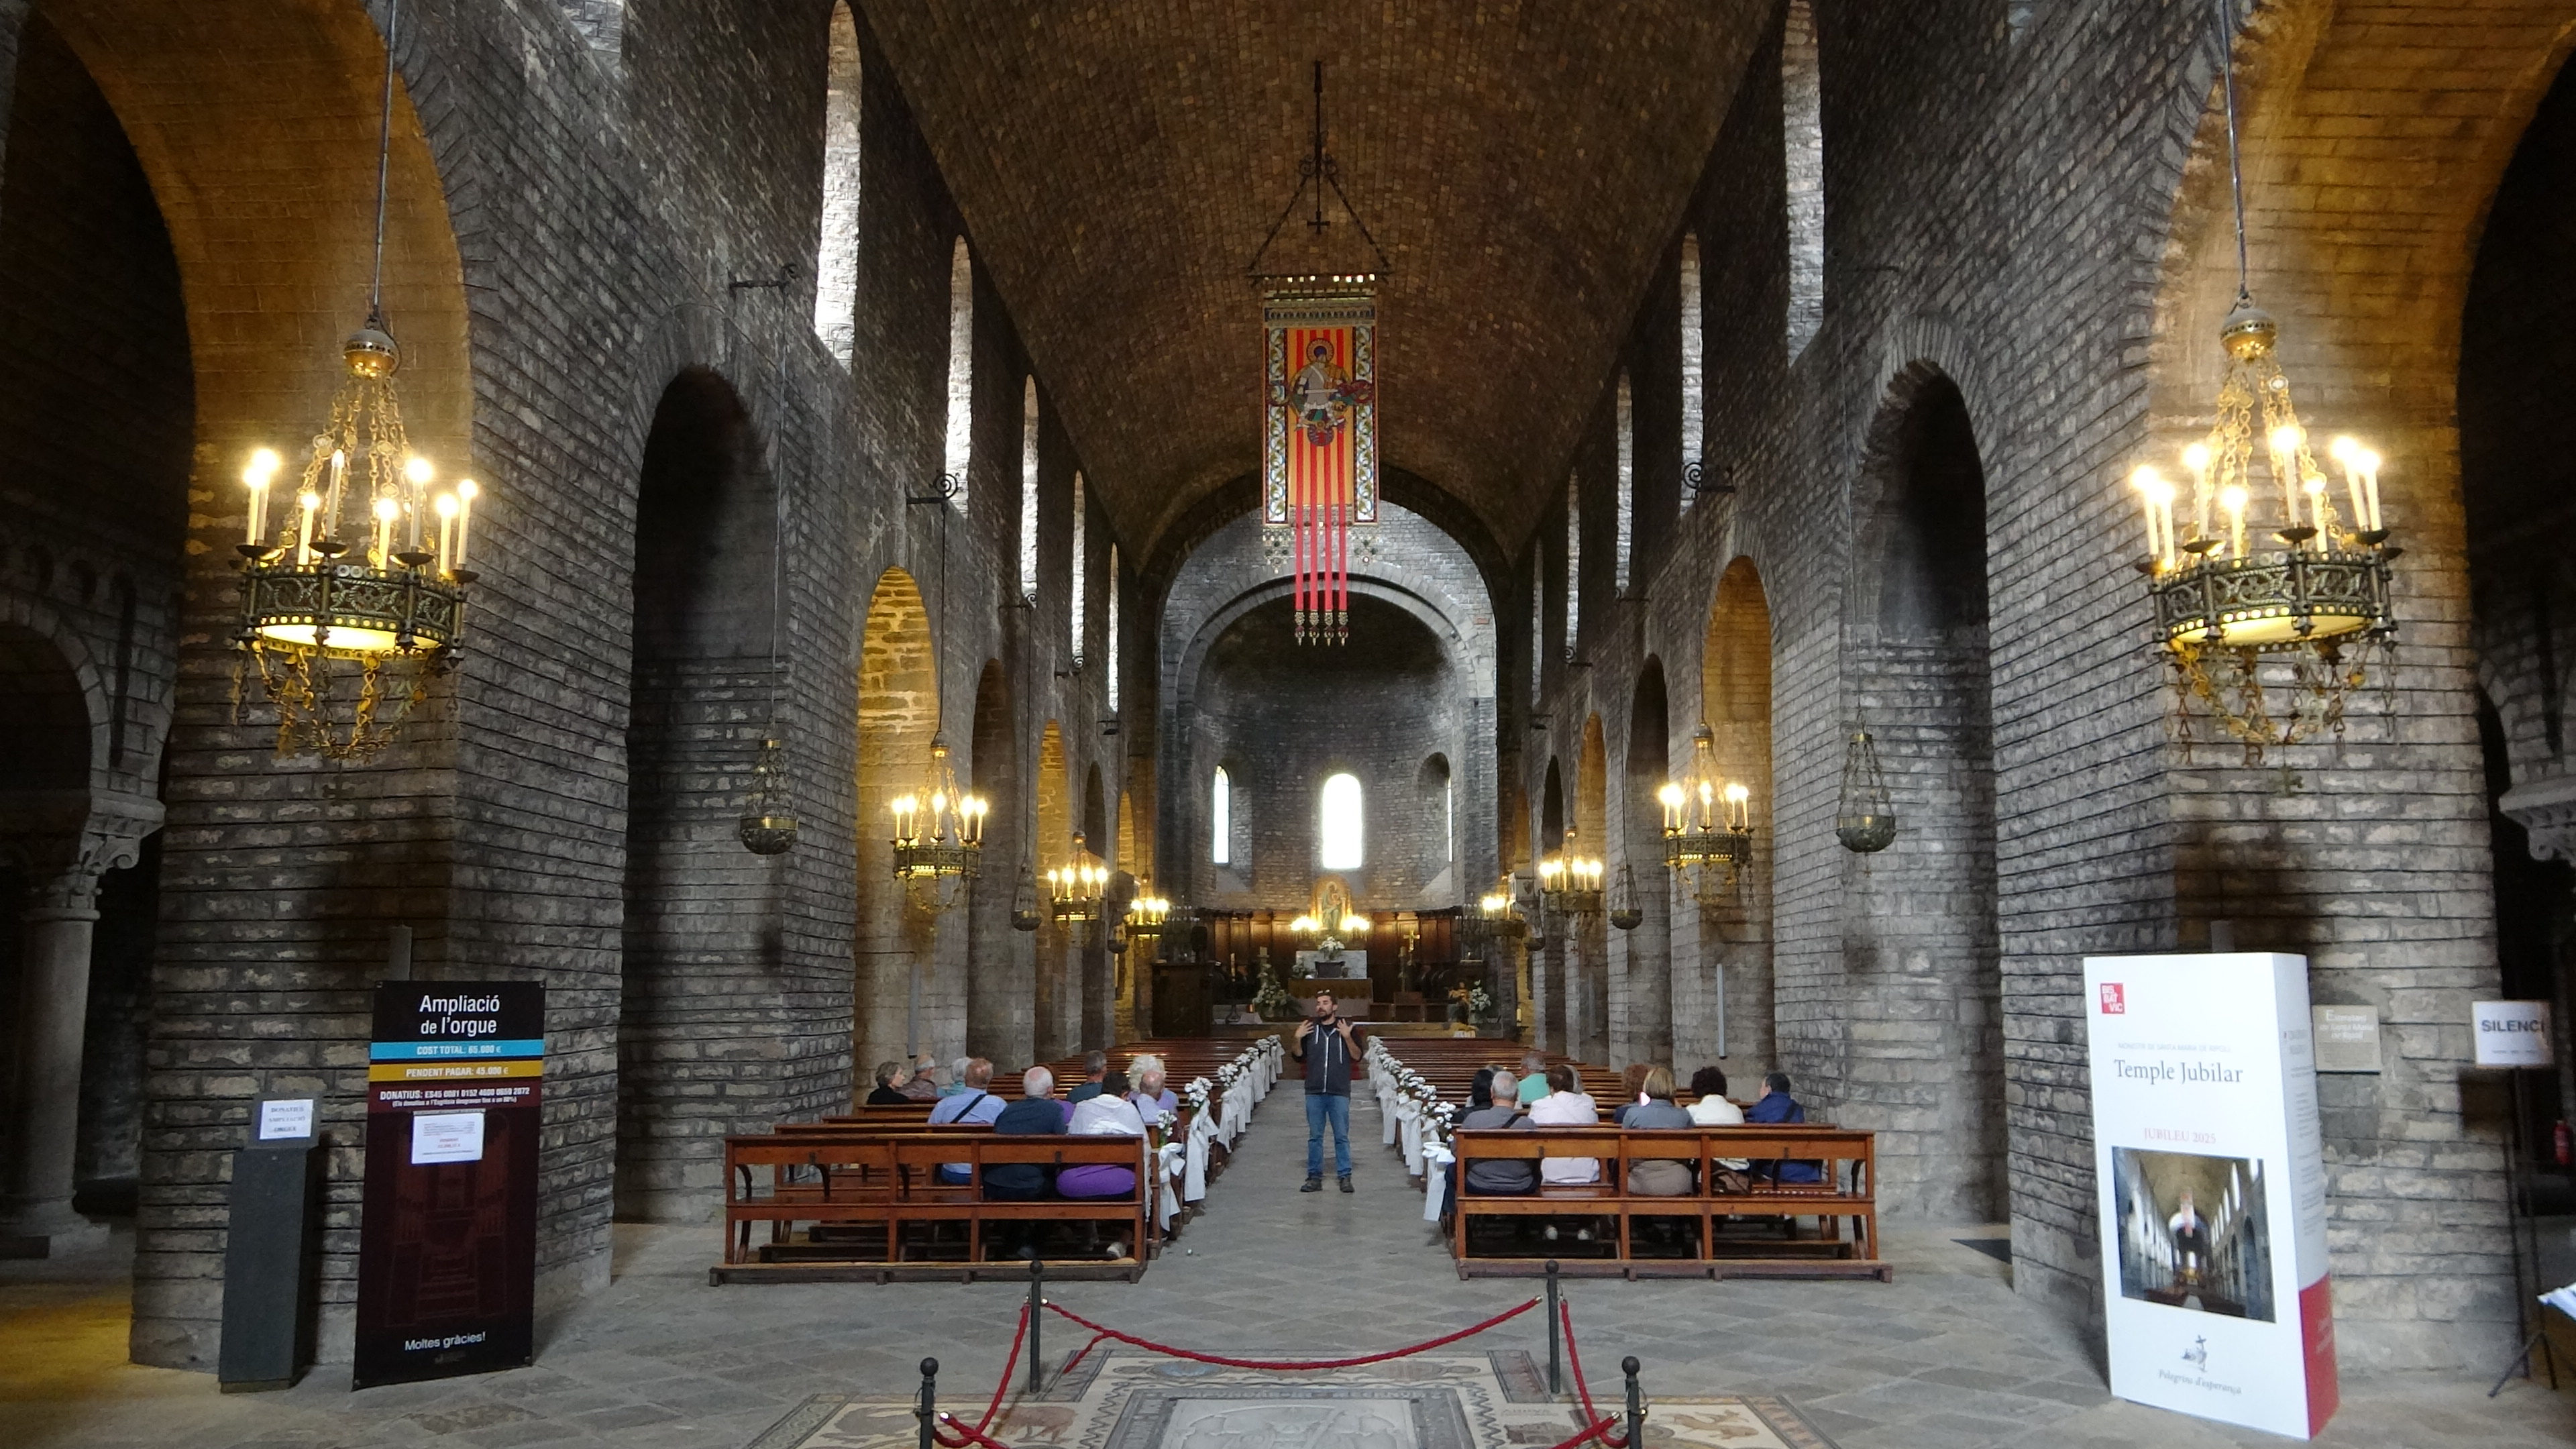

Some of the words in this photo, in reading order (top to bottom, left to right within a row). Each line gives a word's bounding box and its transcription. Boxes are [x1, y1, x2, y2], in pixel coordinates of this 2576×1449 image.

[419, 994, 500, 1016] Ampliació
[421, 1020, 437, 1034] de
[2481, 1019, 2544, 1032] SILENCI
[416, 1045, 438, 1055] COST
[439, 1044, 466, 1055] TOTAL:
[406, 1067, 443, 1077] PENDENT
[445, 1067, 474, 1077] PAGAR:
[2114, 1059, 2176, 1085] Temple
[2180, 1061, 2244, 1085] Jubilar
[380, 1089, 423, 1101] DONATIUS:
[2144, 1127, 2190, 1142] JUBILEU
[2193, 1132, 2216, 1144] 2025
[405, 1338, 441, 1351] Moltes
[443, 1331, 486, 1349] gràcies!
